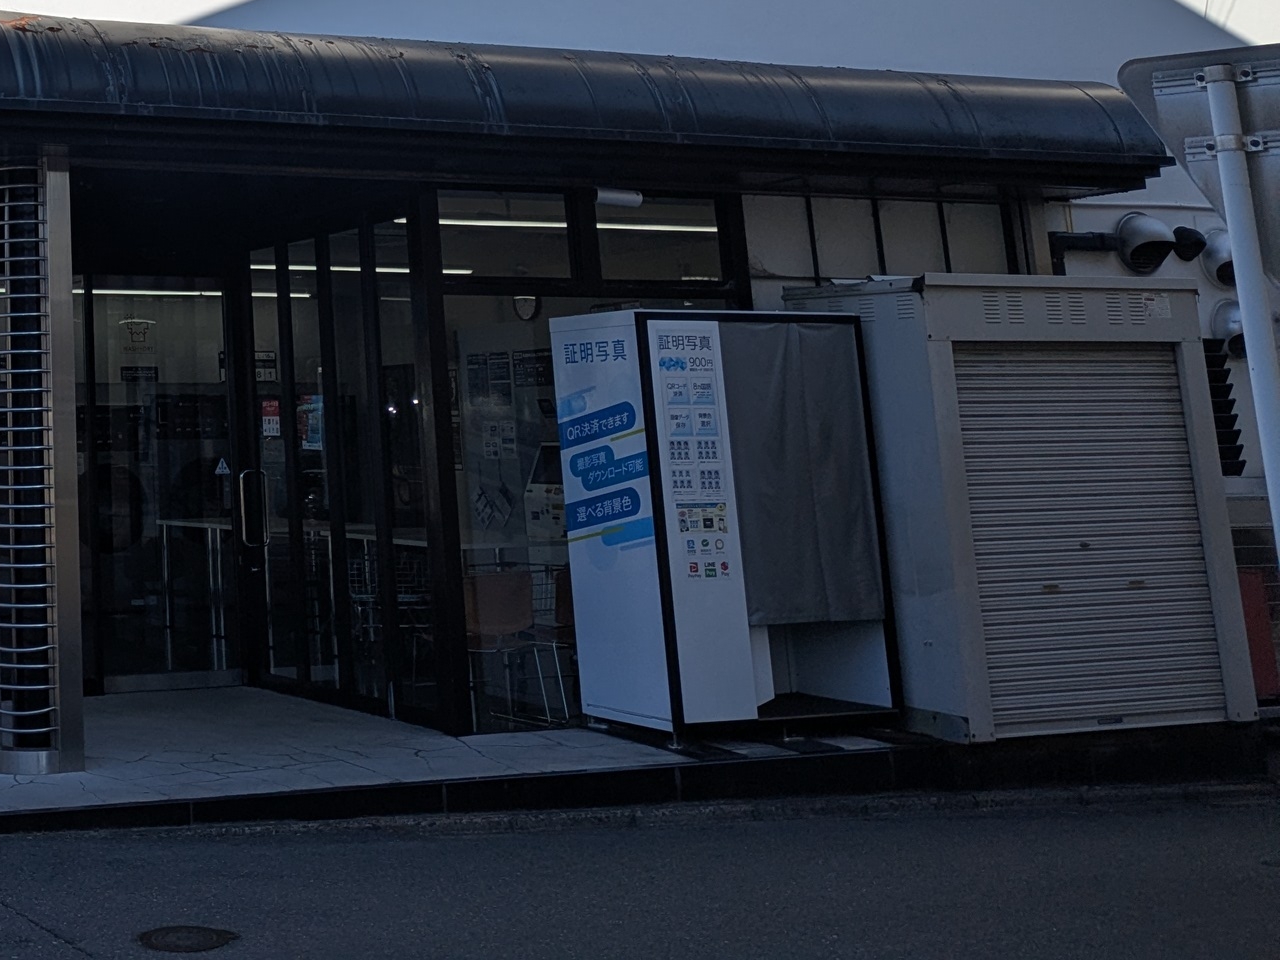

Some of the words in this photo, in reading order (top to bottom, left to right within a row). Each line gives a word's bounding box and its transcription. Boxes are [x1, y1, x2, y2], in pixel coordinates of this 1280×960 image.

[563, 339, 627, 365] 証明写真
[658, 335, 712, 351] 証明写真
[689, 357, 713, 368] 900円
[566, 412, 629, 440] QR決済できます
[577, 451, 607, 471] 撮影写真
[588, 458, 644, 484] ダウンロード可能
[576, 496, 632, 523] 選べる背景色
